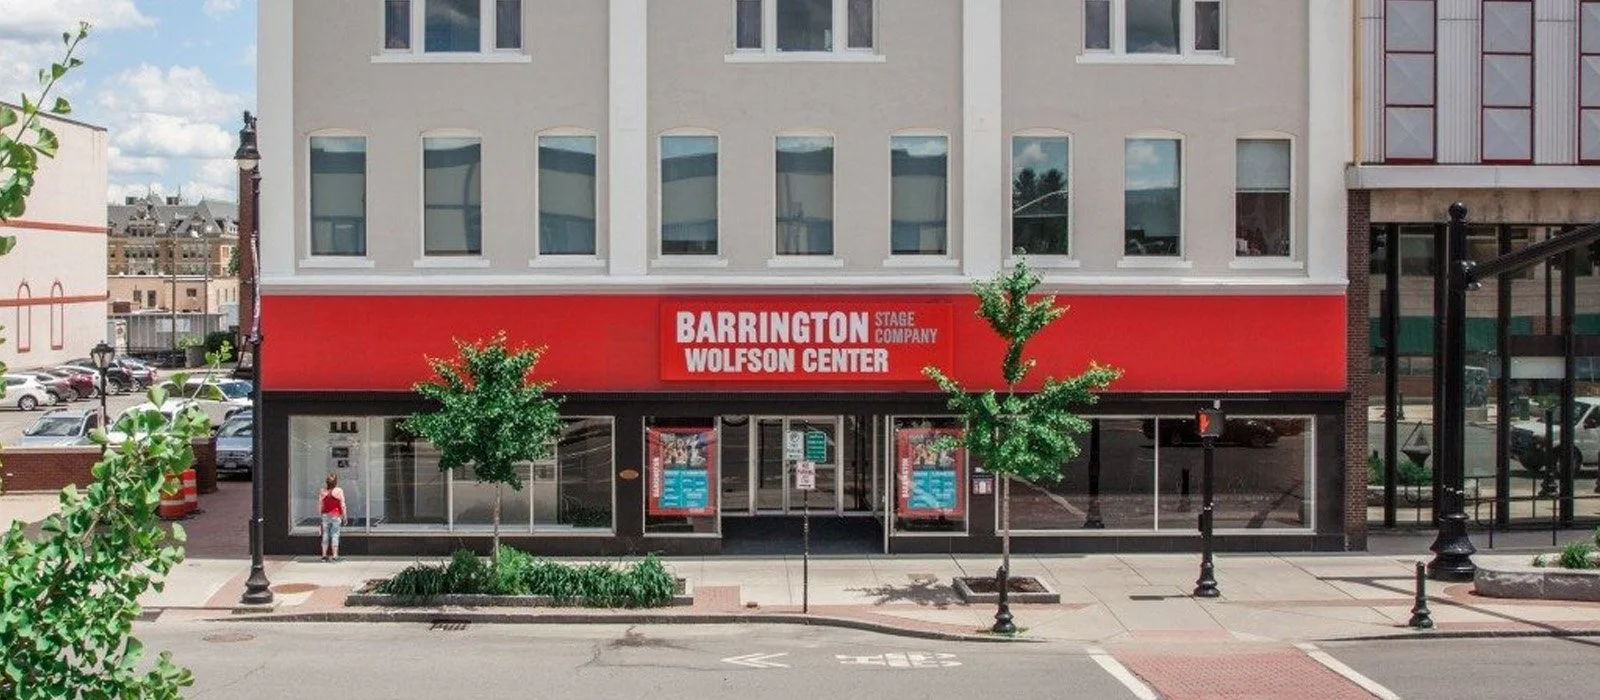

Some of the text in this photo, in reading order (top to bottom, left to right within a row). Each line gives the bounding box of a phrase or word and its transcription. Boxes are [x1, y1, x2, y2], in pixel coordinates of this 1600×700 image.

[677, 311, 868, 343] BARRINGTON
[875, 312, 914, 326] STAGE
[876, 329, 937, 343] COMPANY
[685, 348, 888, 372] WOLFSON CENTER
